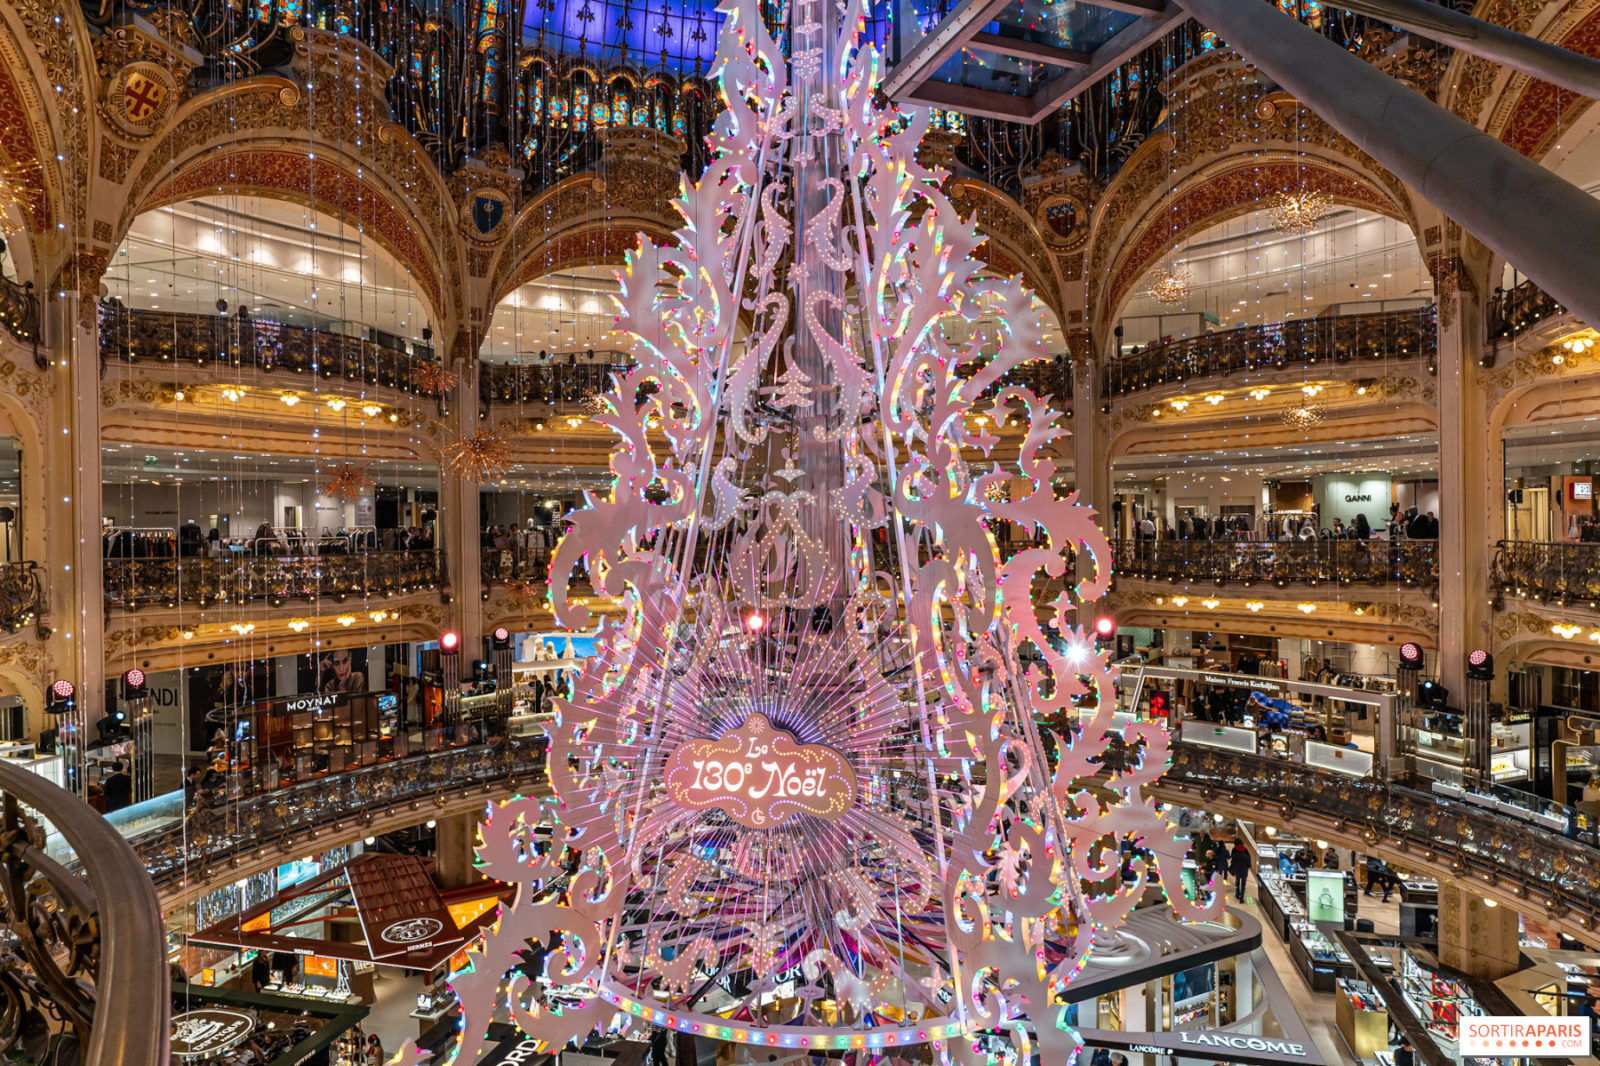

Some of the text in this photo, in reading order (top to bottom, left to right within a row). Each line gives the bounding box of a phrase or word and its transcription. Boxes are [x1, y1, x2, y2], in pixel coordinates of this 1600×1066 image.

[1205, 676, 1279, 691] Maison Francis Kurkdjian
[147, 688, 177, 706] NDI
[287, 695, 338, 711] MOYNAT
[1510, 713, 1530, 721] CHANEL
[745, 737, 768, 758] Le
[748, 761, 827, 799] Noël
